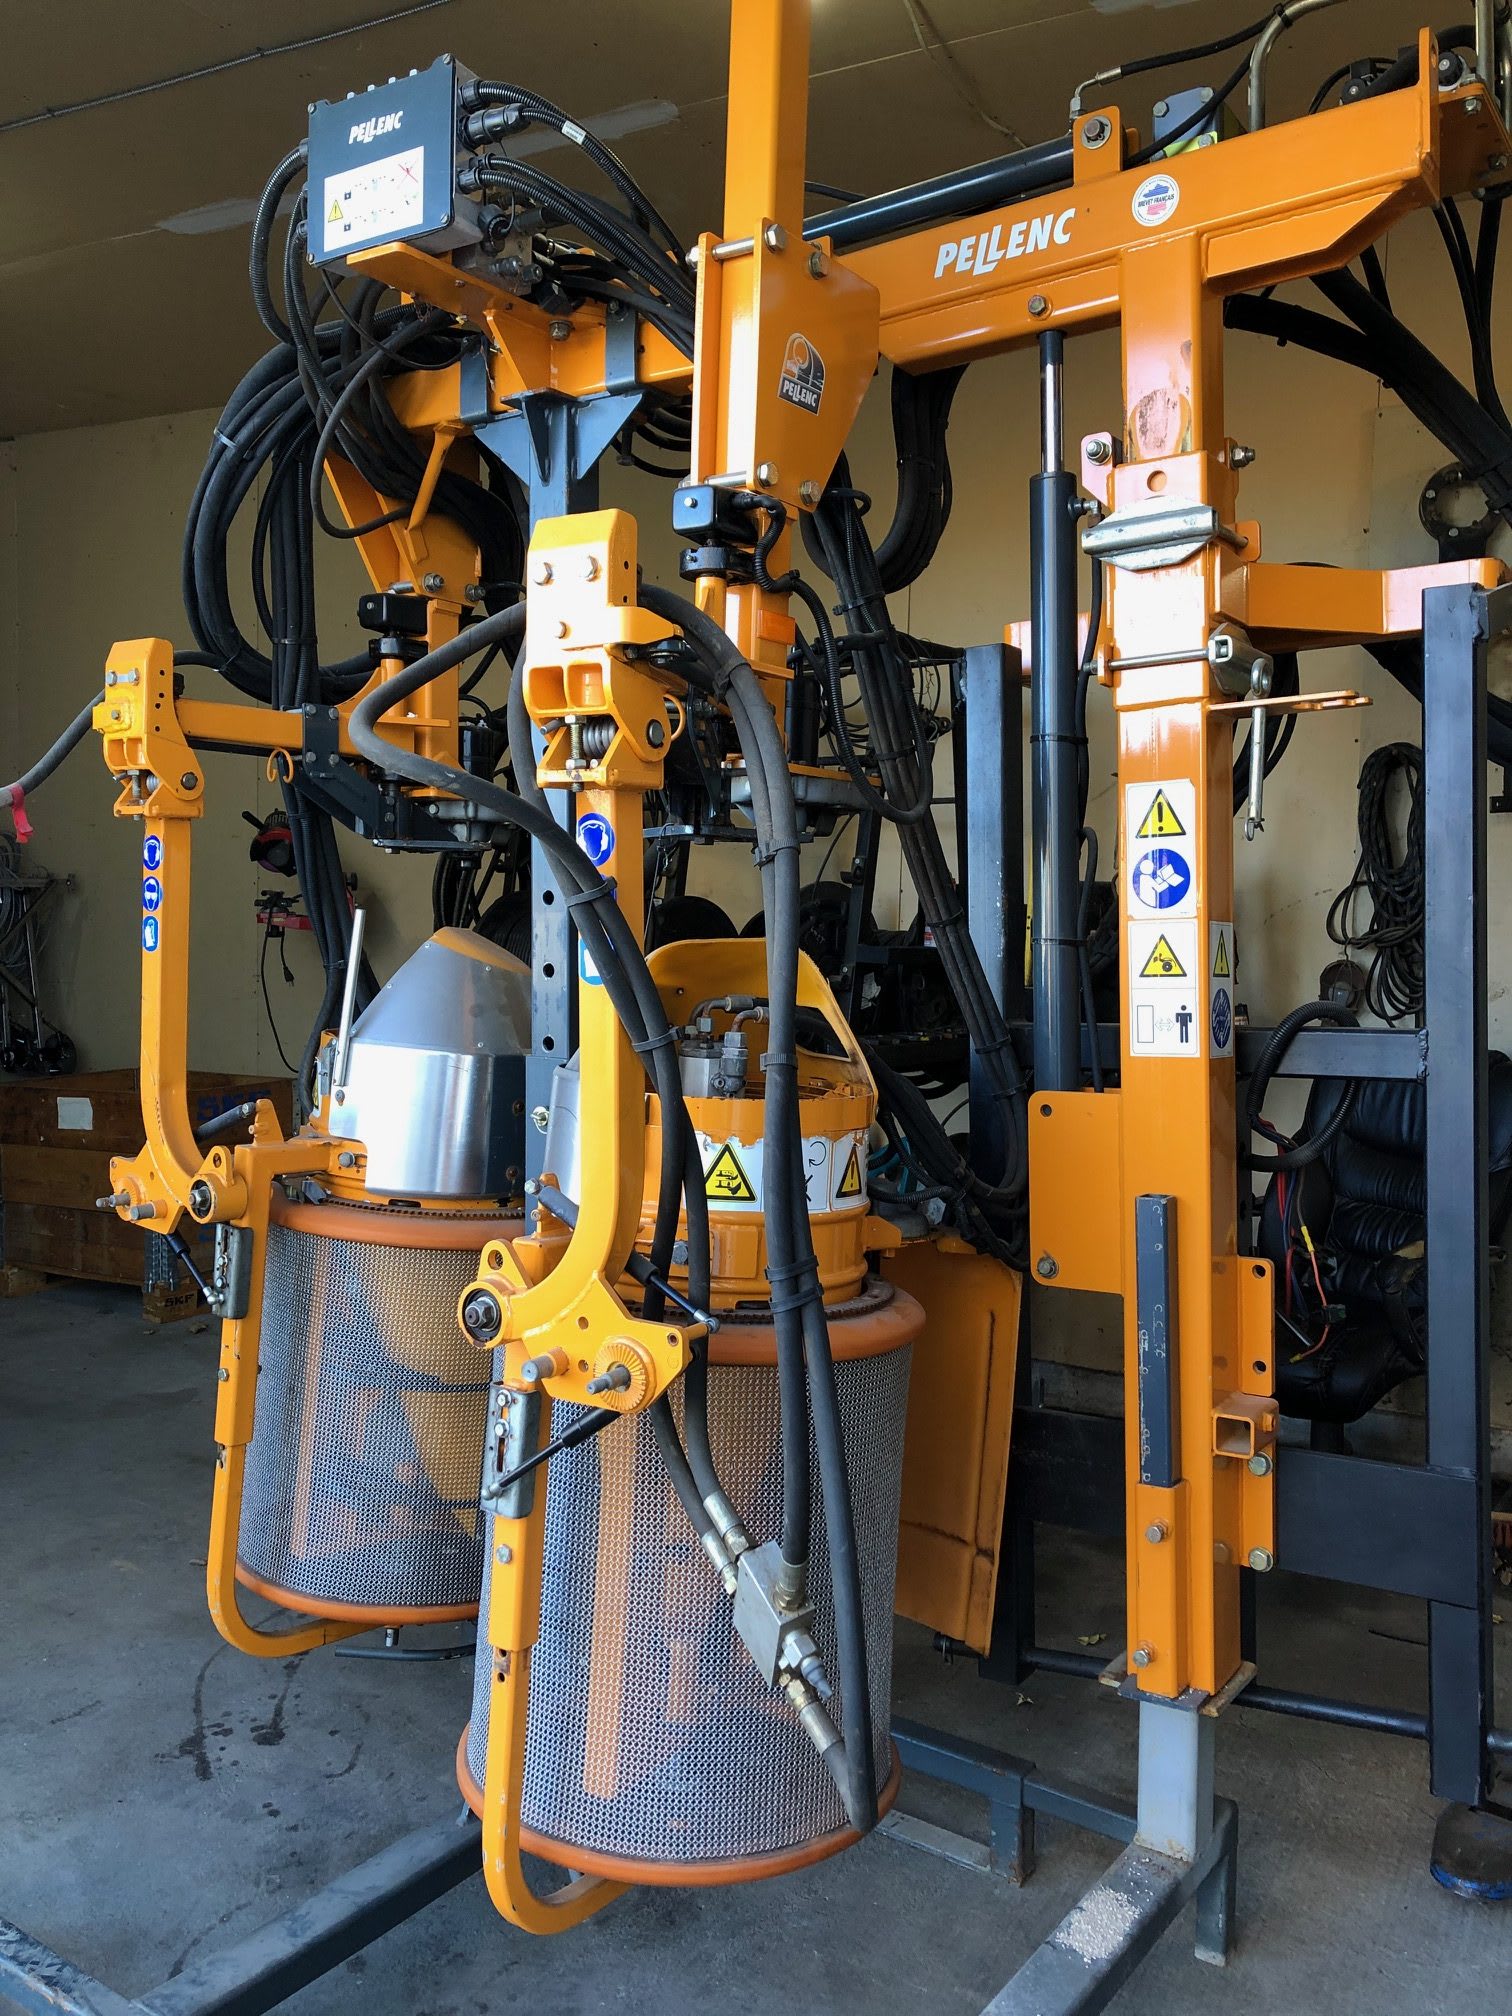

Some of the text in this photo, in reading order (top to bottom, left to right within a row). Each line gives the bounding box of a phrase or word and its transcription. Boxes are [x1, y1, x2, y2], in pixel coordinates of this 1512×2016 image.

[348, 110, 404, 145] PELLENC
[934, 208, 1076, 279] PELLENC
[782, 379, 818, 407] PELLENC
[165, 1294, 194, 1307] SKF
